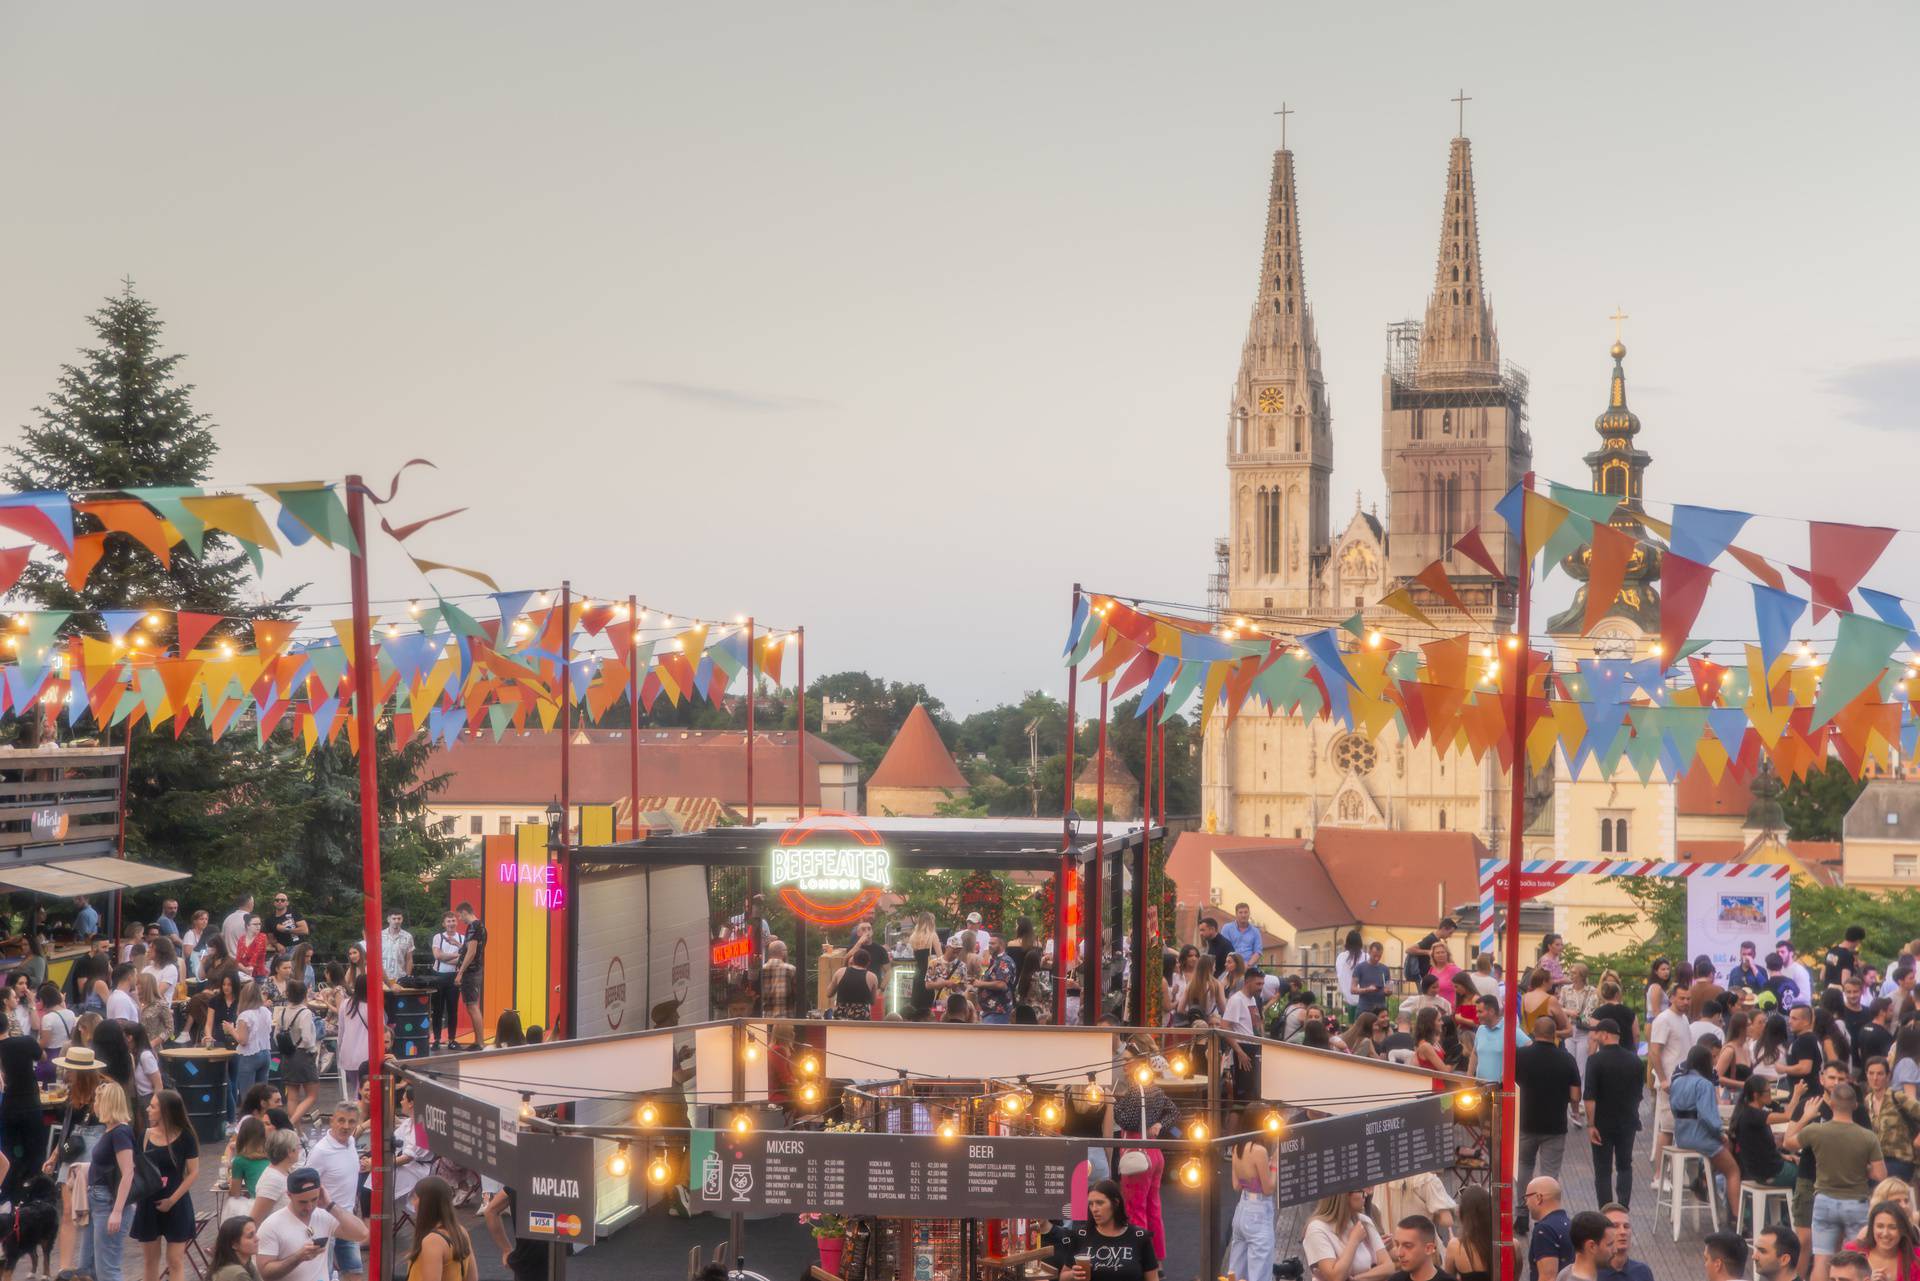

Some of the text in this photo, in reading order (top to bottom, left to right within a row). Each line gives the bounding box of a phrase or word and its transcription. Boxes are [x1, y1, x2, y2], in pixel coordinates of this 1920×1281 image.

[500, 863, 556, 884] MAKE
[772, 849, 890, 885] BEEFEATER
[800, 879, 861, 890] LONDON
[425, 1103, 447, 1136] COFFEE
[766, 1140, 804, 1154] MIXERS
[969, 1145, 994, 1159] BEER
[1280, 1139, 1299, 1154] MIXERS
[532, 1176, 580, 1199] NAPLATA
[535, 1217, 550, 1227] VISA
[1086, 1245, 1133, 1260] LOVE
